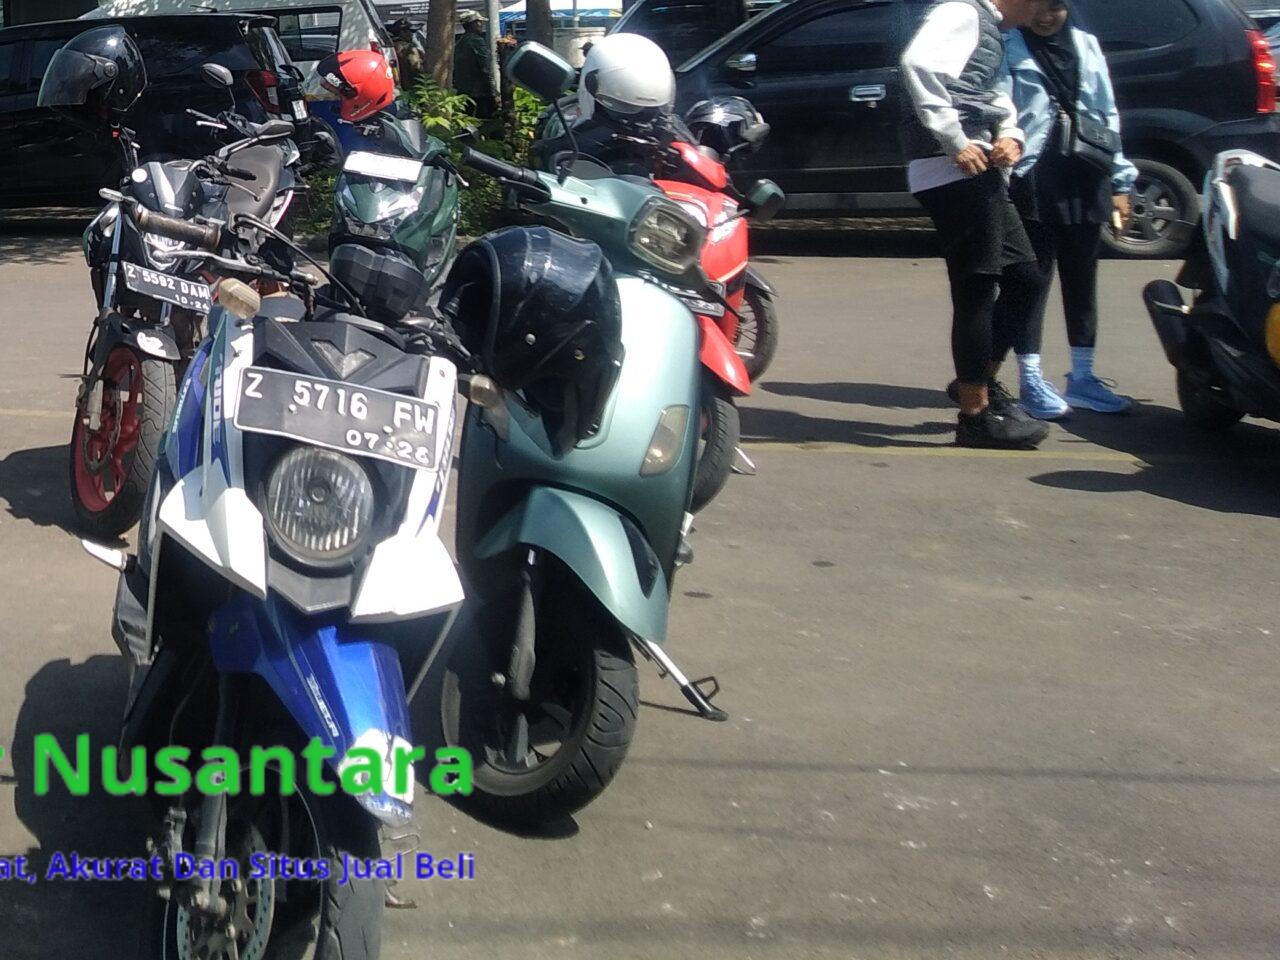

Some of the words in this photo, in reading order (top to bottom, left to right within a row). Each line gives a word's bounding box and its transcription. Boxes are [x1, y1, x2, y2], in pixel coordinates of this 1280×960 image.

[126, 265, 136, 279] Z
[180, 281, 209, 300] DAM
[244, 372, 264, 399] Z
[292, 379, 368, 420] 5716
[393, 400, 435, 435] FW
